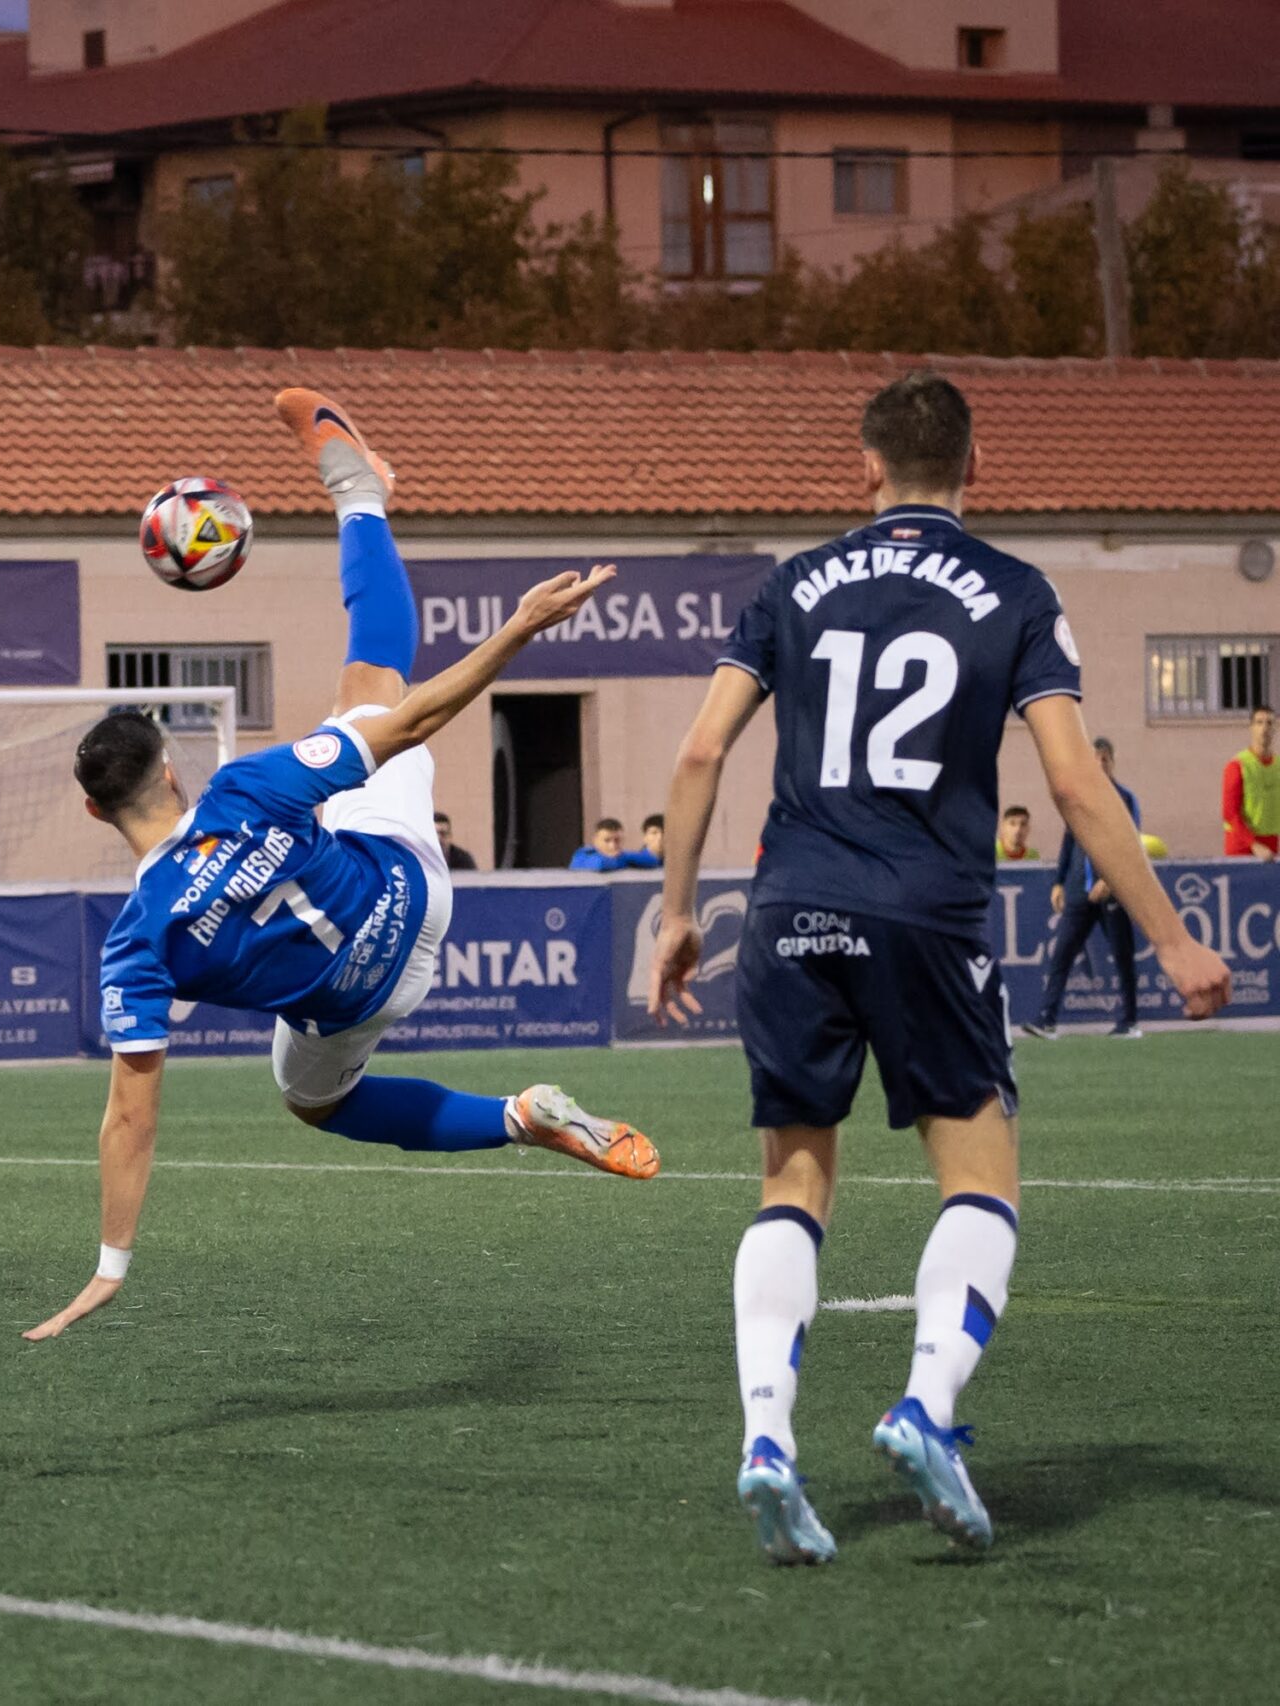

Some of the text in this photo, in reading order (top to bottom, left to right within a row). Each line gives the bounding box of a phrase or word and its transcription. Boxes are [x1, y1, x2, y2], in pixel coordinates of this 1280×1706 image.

[791, 546, 1001, 622] DIAZ DE ALDA
[810, 629, 959, 791] 12
[223, 825, 295, 903] IGLESIAS
[250, 879, 345, 955] 7
[381, 864, 406, 959] LUJAMA
[1106, 869, 1280, 964] olc
